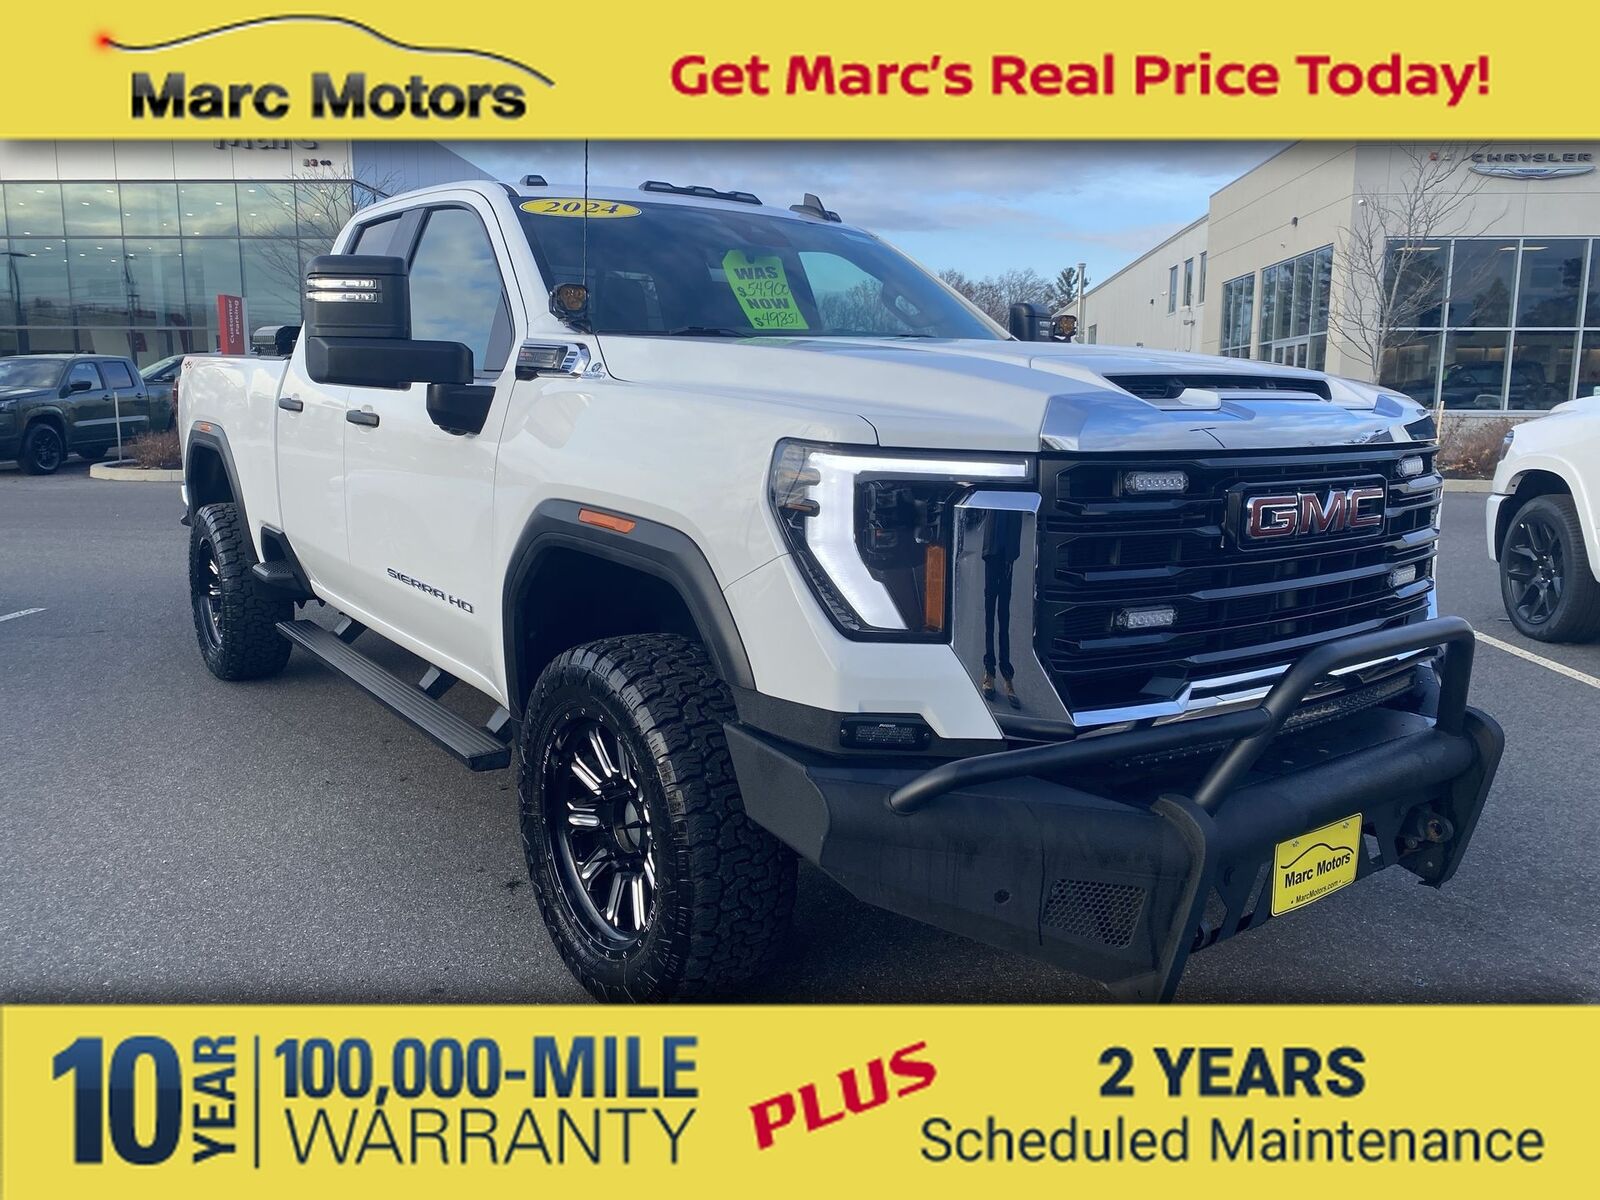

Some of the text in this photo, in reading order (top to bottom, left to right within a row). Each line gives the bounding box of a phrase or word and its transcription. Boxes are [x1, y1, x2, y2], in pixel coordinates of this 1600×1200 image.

[1471, 152, 1592, 163] CHRYSLER
[542, 201, 619, 214] 2024
[734, 266, 778, 280] WAS
[746, 298, 789, 309] NOW
[1246, 488, 1384, 537] GMC
[387, 567, 474, 614] SIERRA HD
[1285, 853, 1350, 888] Marc Motors
